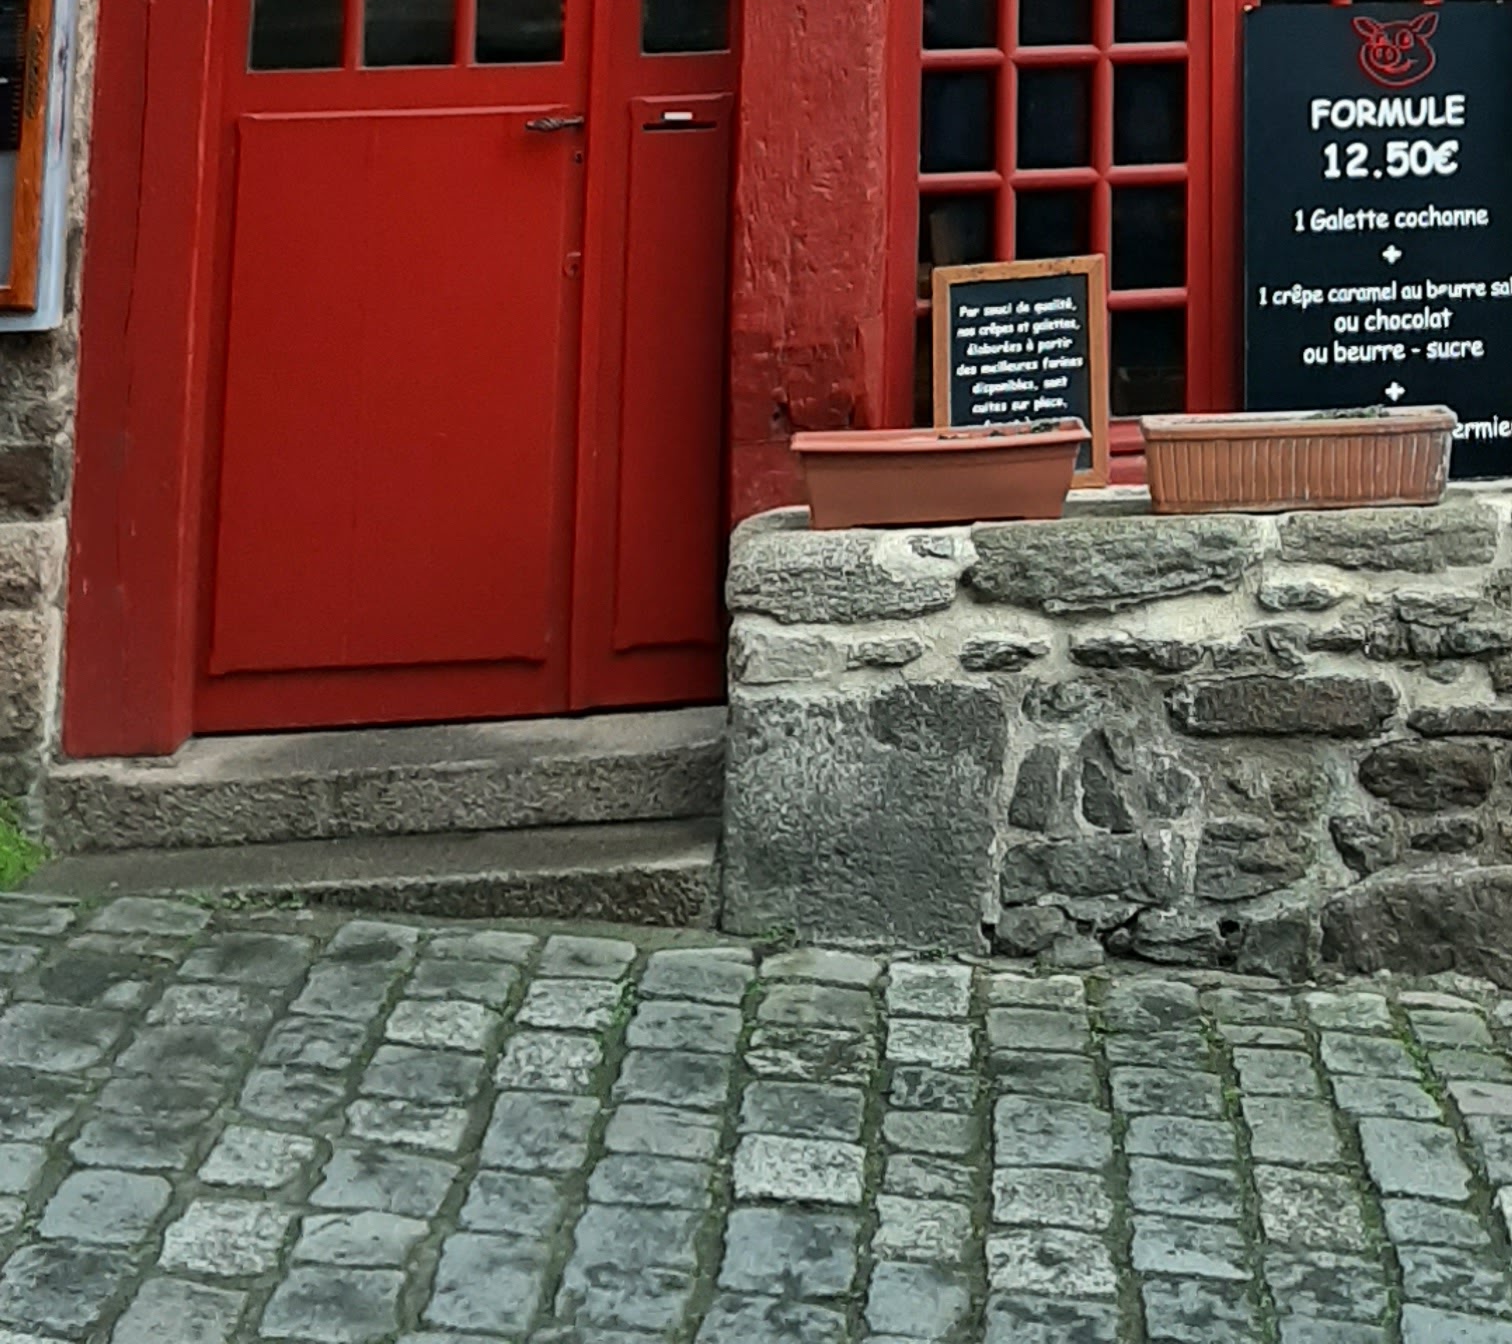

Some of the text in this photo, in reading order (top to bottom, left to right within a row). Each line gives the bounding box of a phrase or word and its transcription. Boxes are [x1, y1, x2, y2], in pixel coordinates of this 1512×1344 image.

[1311, 94, 1466, 130] FORMULE
[1324, 139, 1459, 179] 12.50€
[1295, 204, 1489, 232] 1 Galette cochonne
[1259, 286, 1268, 306] 1
[1272, 283, 1324, 309] crêpe
[1327, 280, 1397, 303] caramel
[1400, 285, 1423, 300] au
[1426, 279, 1487, 300] beurre
[1334, 305, 1453, 333] ou chocolat
[1303, 346, 1328, 365] ou
[1333, 340, 1406, 363] beurre
[1426, 340, 1485, 359] sucre
[956, 364, 977, 376] des
